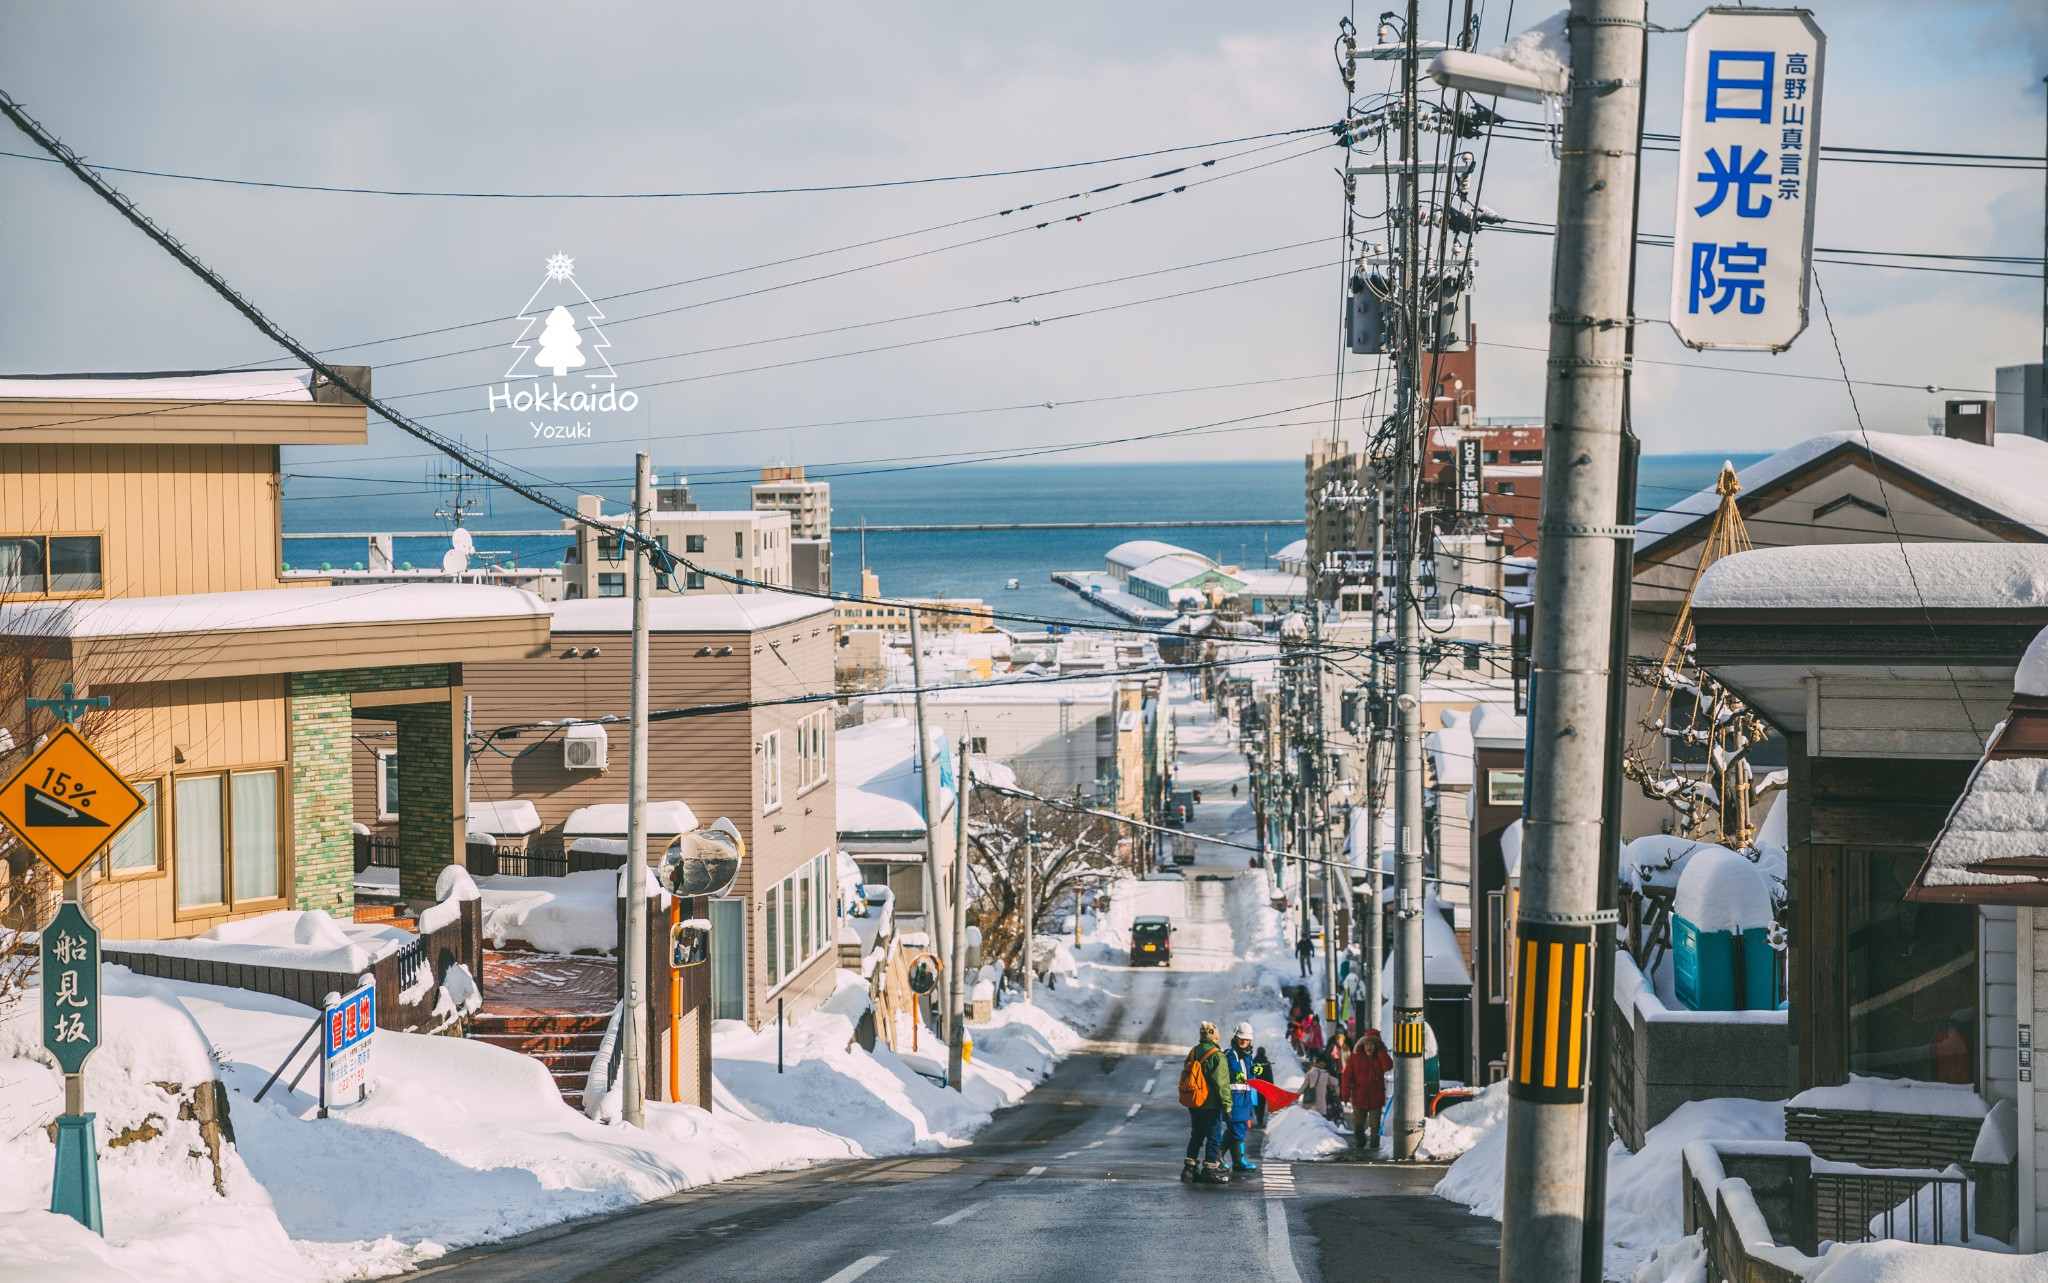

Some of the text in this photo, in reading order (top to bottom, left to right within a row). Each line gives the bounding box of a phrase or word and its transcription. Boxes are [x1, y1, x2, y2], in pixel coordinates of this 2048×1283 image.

[1777, 53, 1808, 200] 高野山真言宗
[1688, 50, 1776, 315] 日光院
[1464, 441, 1476, 480] HOTEL
[41, 767, 97, 808] 15%
[52, 929, 91, 1044] 船見坂
[331, 994, 371, 1052] 管理地
